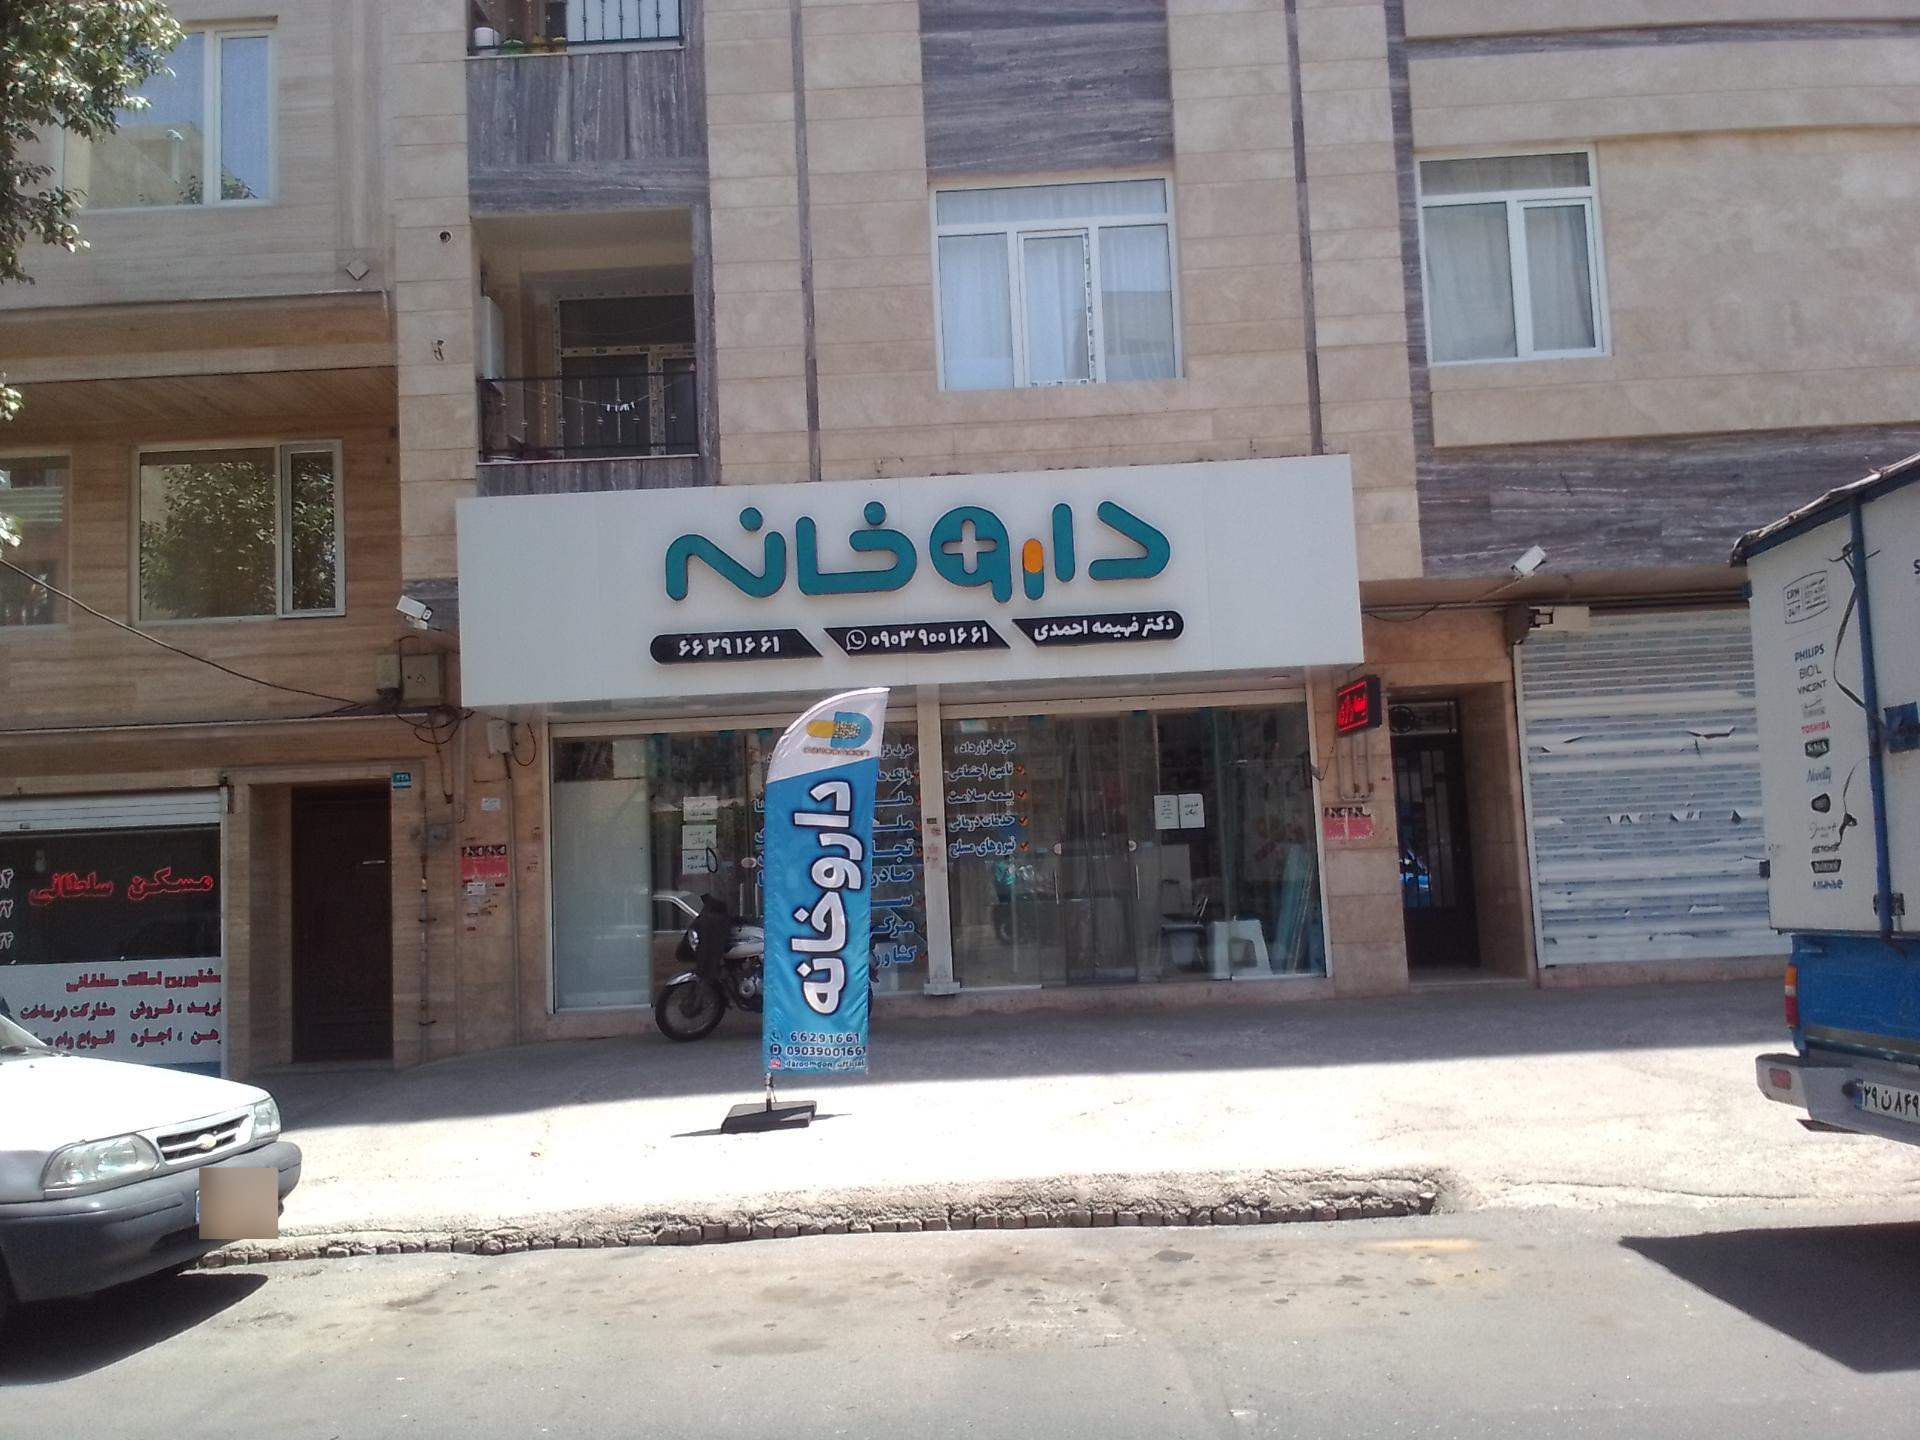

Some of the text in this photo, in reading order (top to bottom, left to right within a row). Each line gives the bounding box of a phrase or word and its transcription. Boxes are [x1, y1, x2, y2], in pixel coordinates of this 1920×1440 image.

[665, 501, 1171, 603] داروخانه
[1034, 615, 1174, 641] دکتر فهیمه احمدی
[1794, 643, 1825, 662] PHILIPS
[994, 738, 1017, 755] طرف
[948, 763, 988, 782] اجتماعی
[947, 788, 1014, 806] بیمه سلامت
[949, 810, 1016, 832] خدمات درمانی
[949, 838, 975, 858] مسلح
[28, 872, 113, 907] سلطانی
[128, 867, 213, 901] مسکن
[791, 781, 863, 1014] داروخانه
[70, 1002, 115, 1021] مشارکت
[130, 999, 174, 1021] فروش
[55, 1030, 74, 1050] وام
[76, 1029, 115, 1049] انواع
[130, 1027, 173, 1047] اجاره
[790, 1031, 860, 1043] 66291661
[787, 1045, 866, 1057] 09039001661
